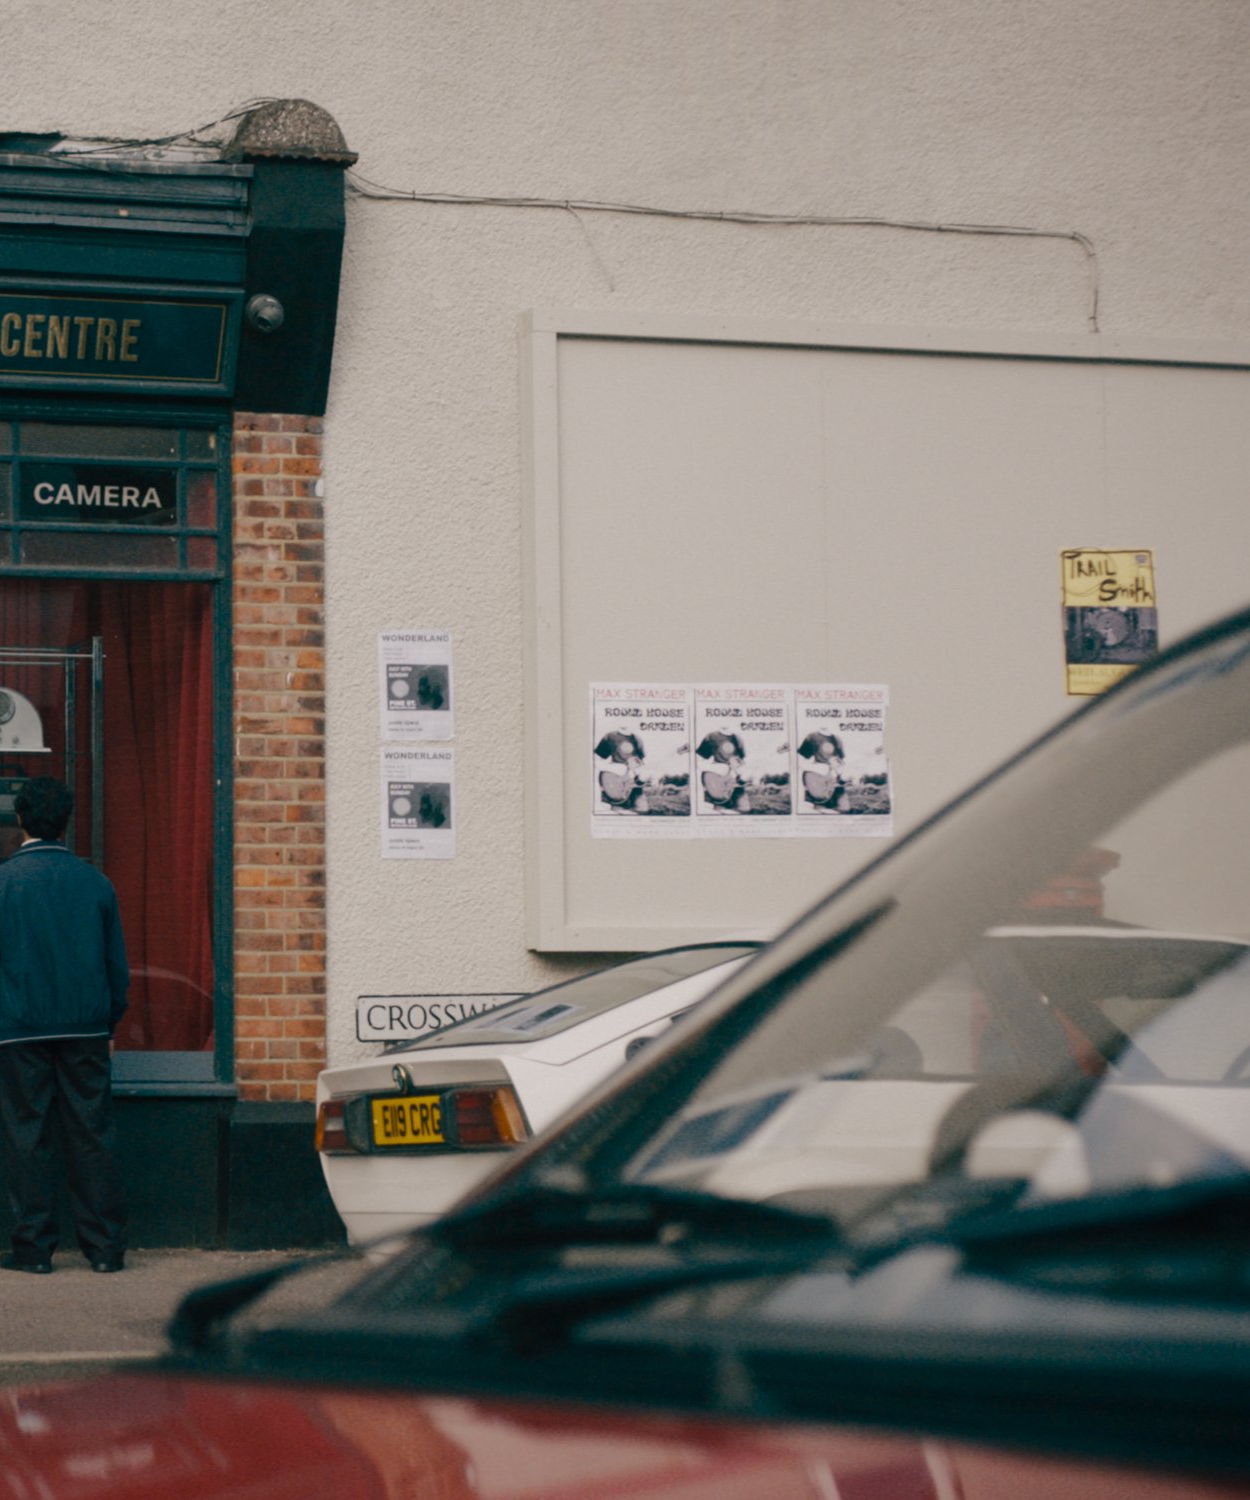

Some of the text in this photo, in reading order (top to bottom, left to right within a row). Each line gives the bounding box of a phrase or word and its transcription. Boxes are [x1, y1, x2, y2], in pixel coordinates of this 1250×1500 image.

[0, 312, 141, 362] CENTRE
[32, 482, 162, 509] CAMERA
[1063, 551, 1117, 579] TRAIL
[1099, 576, 1153, 602] Smith
[382, 634, 449, 642] WONDERLAND
[596, 688, 686, 699] MAX STRANGER
[696, 688, 783, 699] MAX STRANGER
[797, 690, 883, 700] MAX STRANGER
[646, 708, 684, 717] HOUSE
[746, 708, 783, 717] HOUSE
[846, 709, 882, 718] HOUSE
[384, 752, 452, 760] WONDERLAND
[367, 1003, 500, 1031] CROSS
[382, 1103, 442, 1138] E119 CRG
